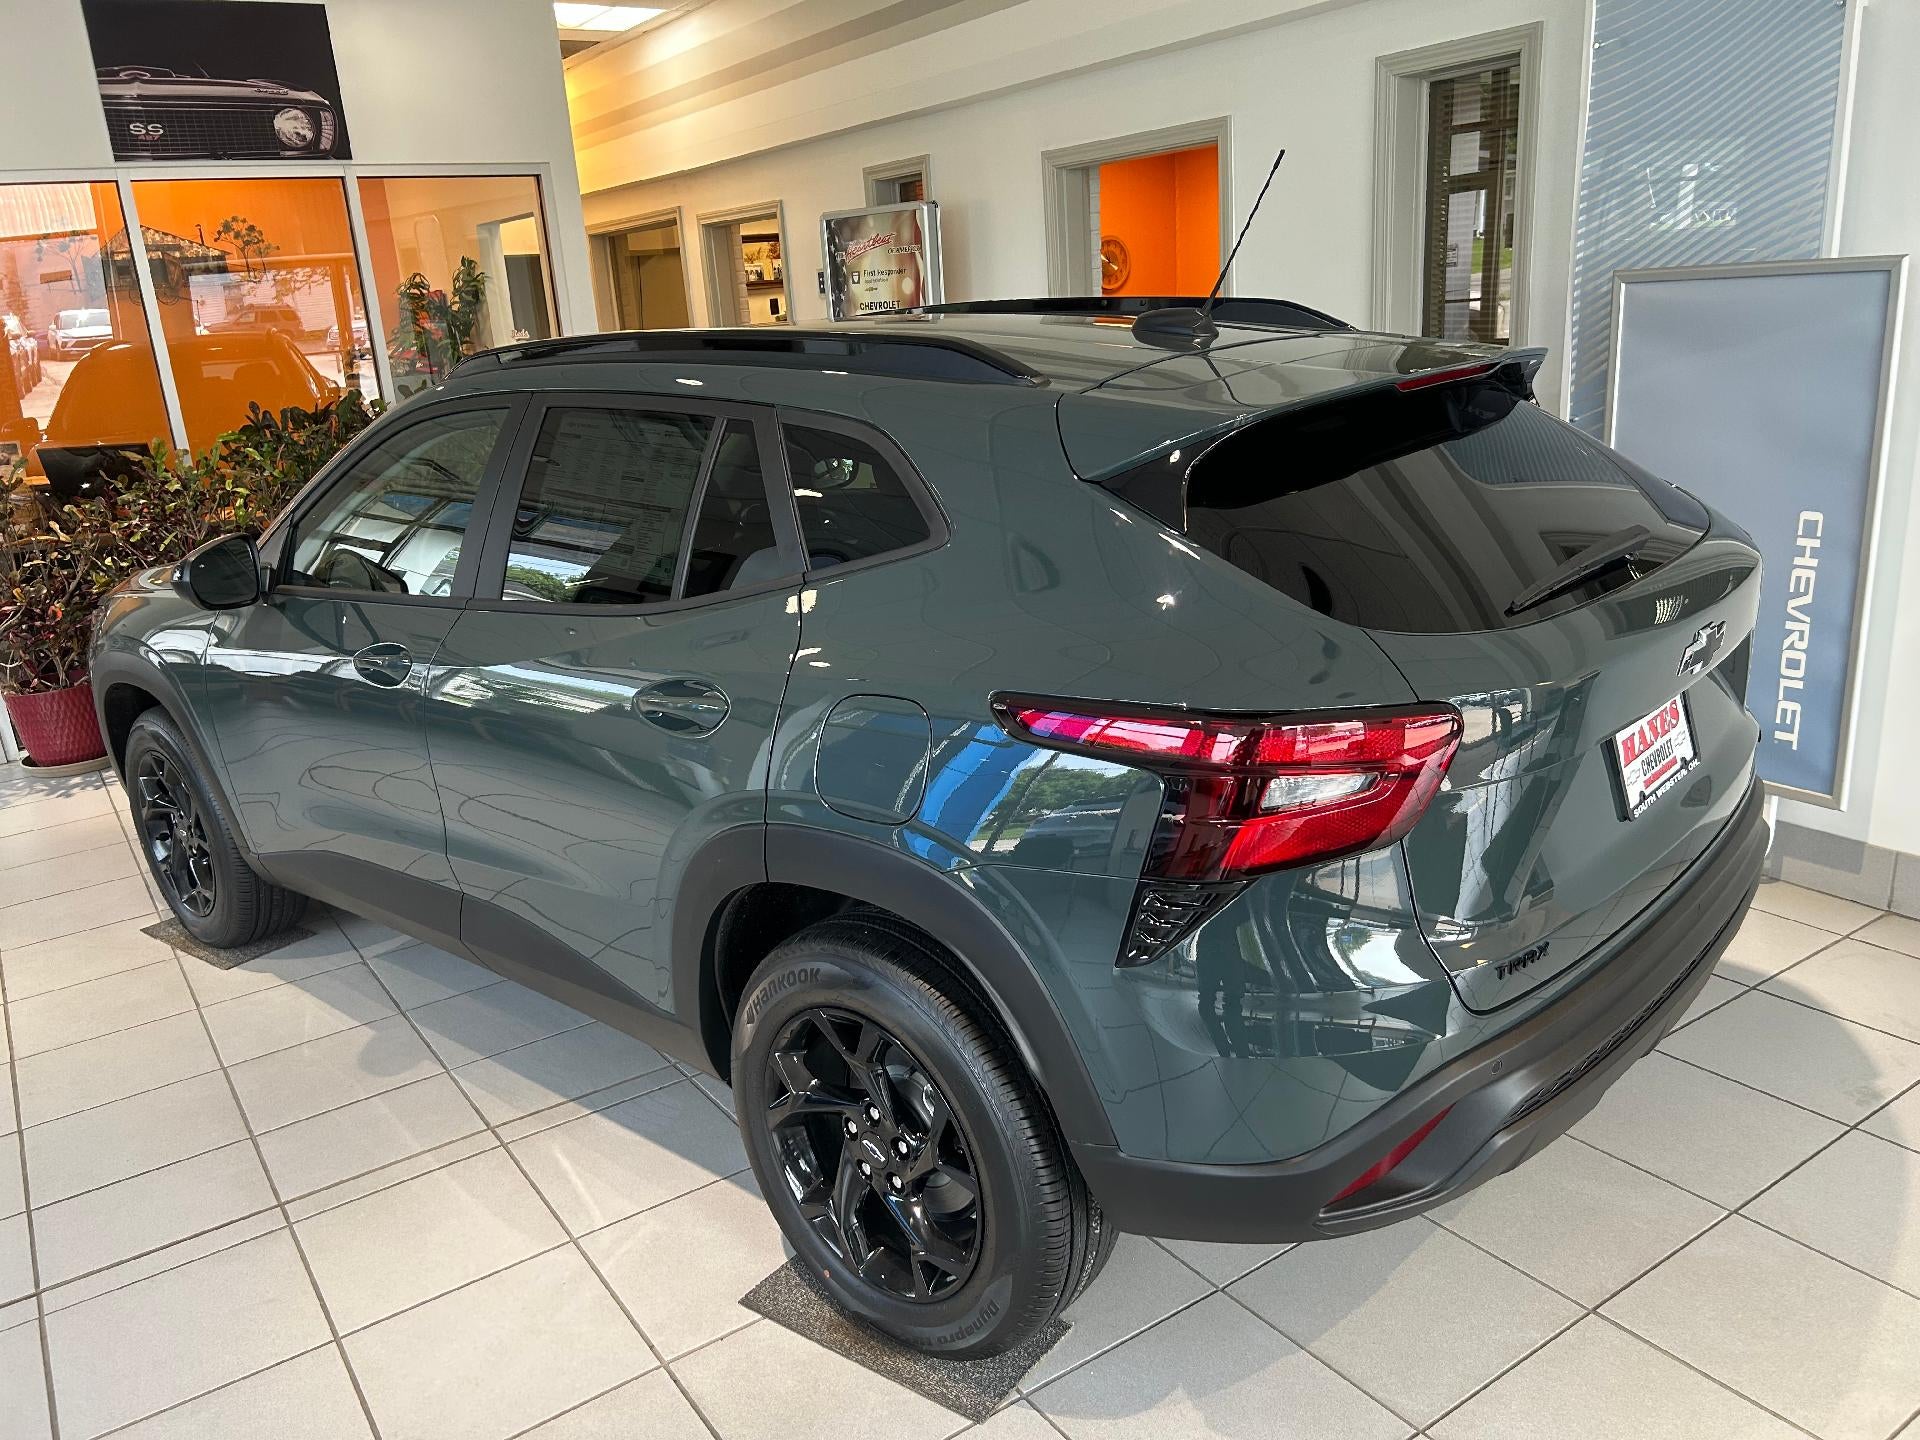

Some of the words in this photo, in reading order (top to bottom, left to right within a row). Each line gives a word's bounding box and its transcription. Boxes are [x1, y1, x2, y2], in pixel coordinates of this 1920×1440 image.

[129, 122, 164, 135] SS
[863, 269, 876, 277] First
[877, 268, 906, 277] Responder
[859, 300, 901, 311] CHEVROLET
[1773, 510, 1824, 751] CHEVROLET
[1621, 699, 1680, 768] HANES
[1641, 738, 1674, 777] CHEVROLET
[1633, 798, 1656, 818] SOUTH
[1495, 941, 1550, 981] TRAX
